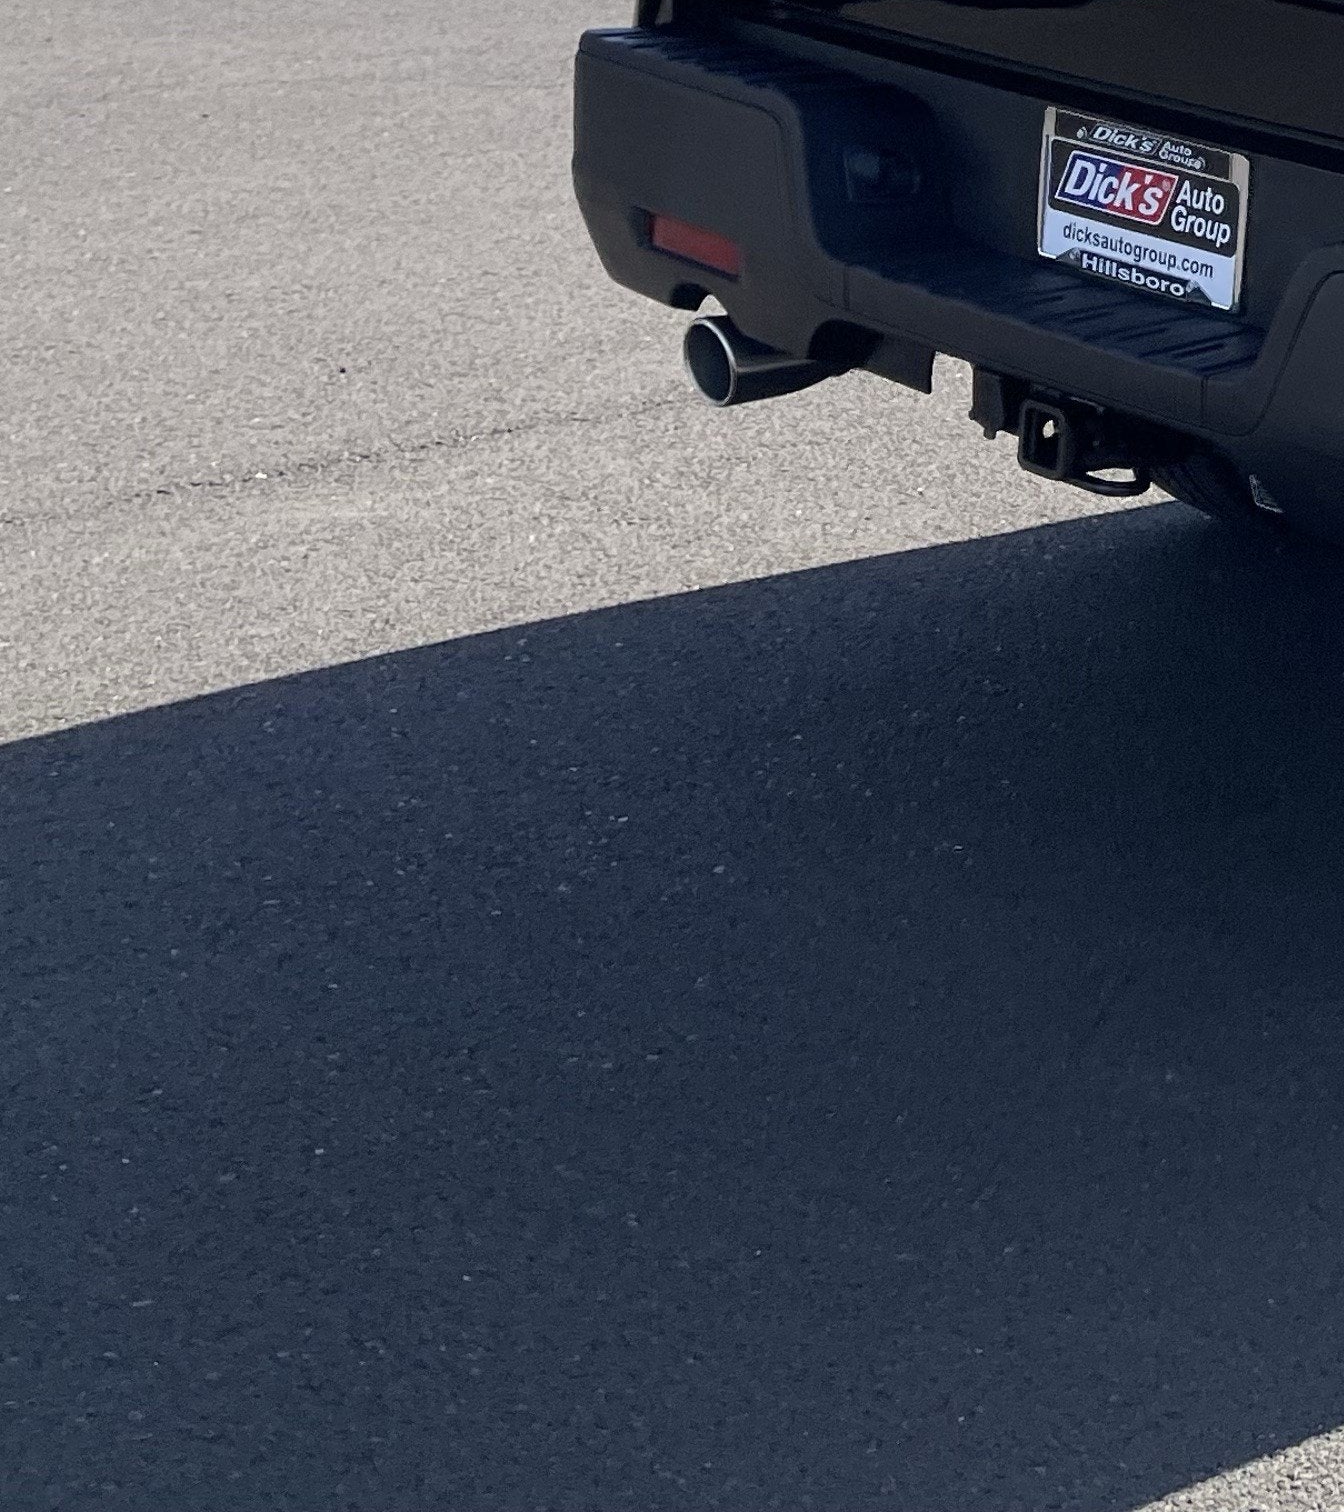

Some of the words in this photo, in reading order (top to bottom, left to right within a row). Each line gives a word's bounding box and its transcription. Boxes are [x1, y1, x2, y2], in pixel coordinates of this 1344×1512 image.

[1093, 126, 1155, 153] Dick's
[1162, 141, 1192, 157] Auto
[1064, 157, 1164, 216] Dick's
[1176, 180, 1225, 215] Auto
[1171, 206, 1231, 248] Group
[1063, 222, 1214, 279] dicksautogroup.com
[1081, 252, 1185, 297] Hillsboro
